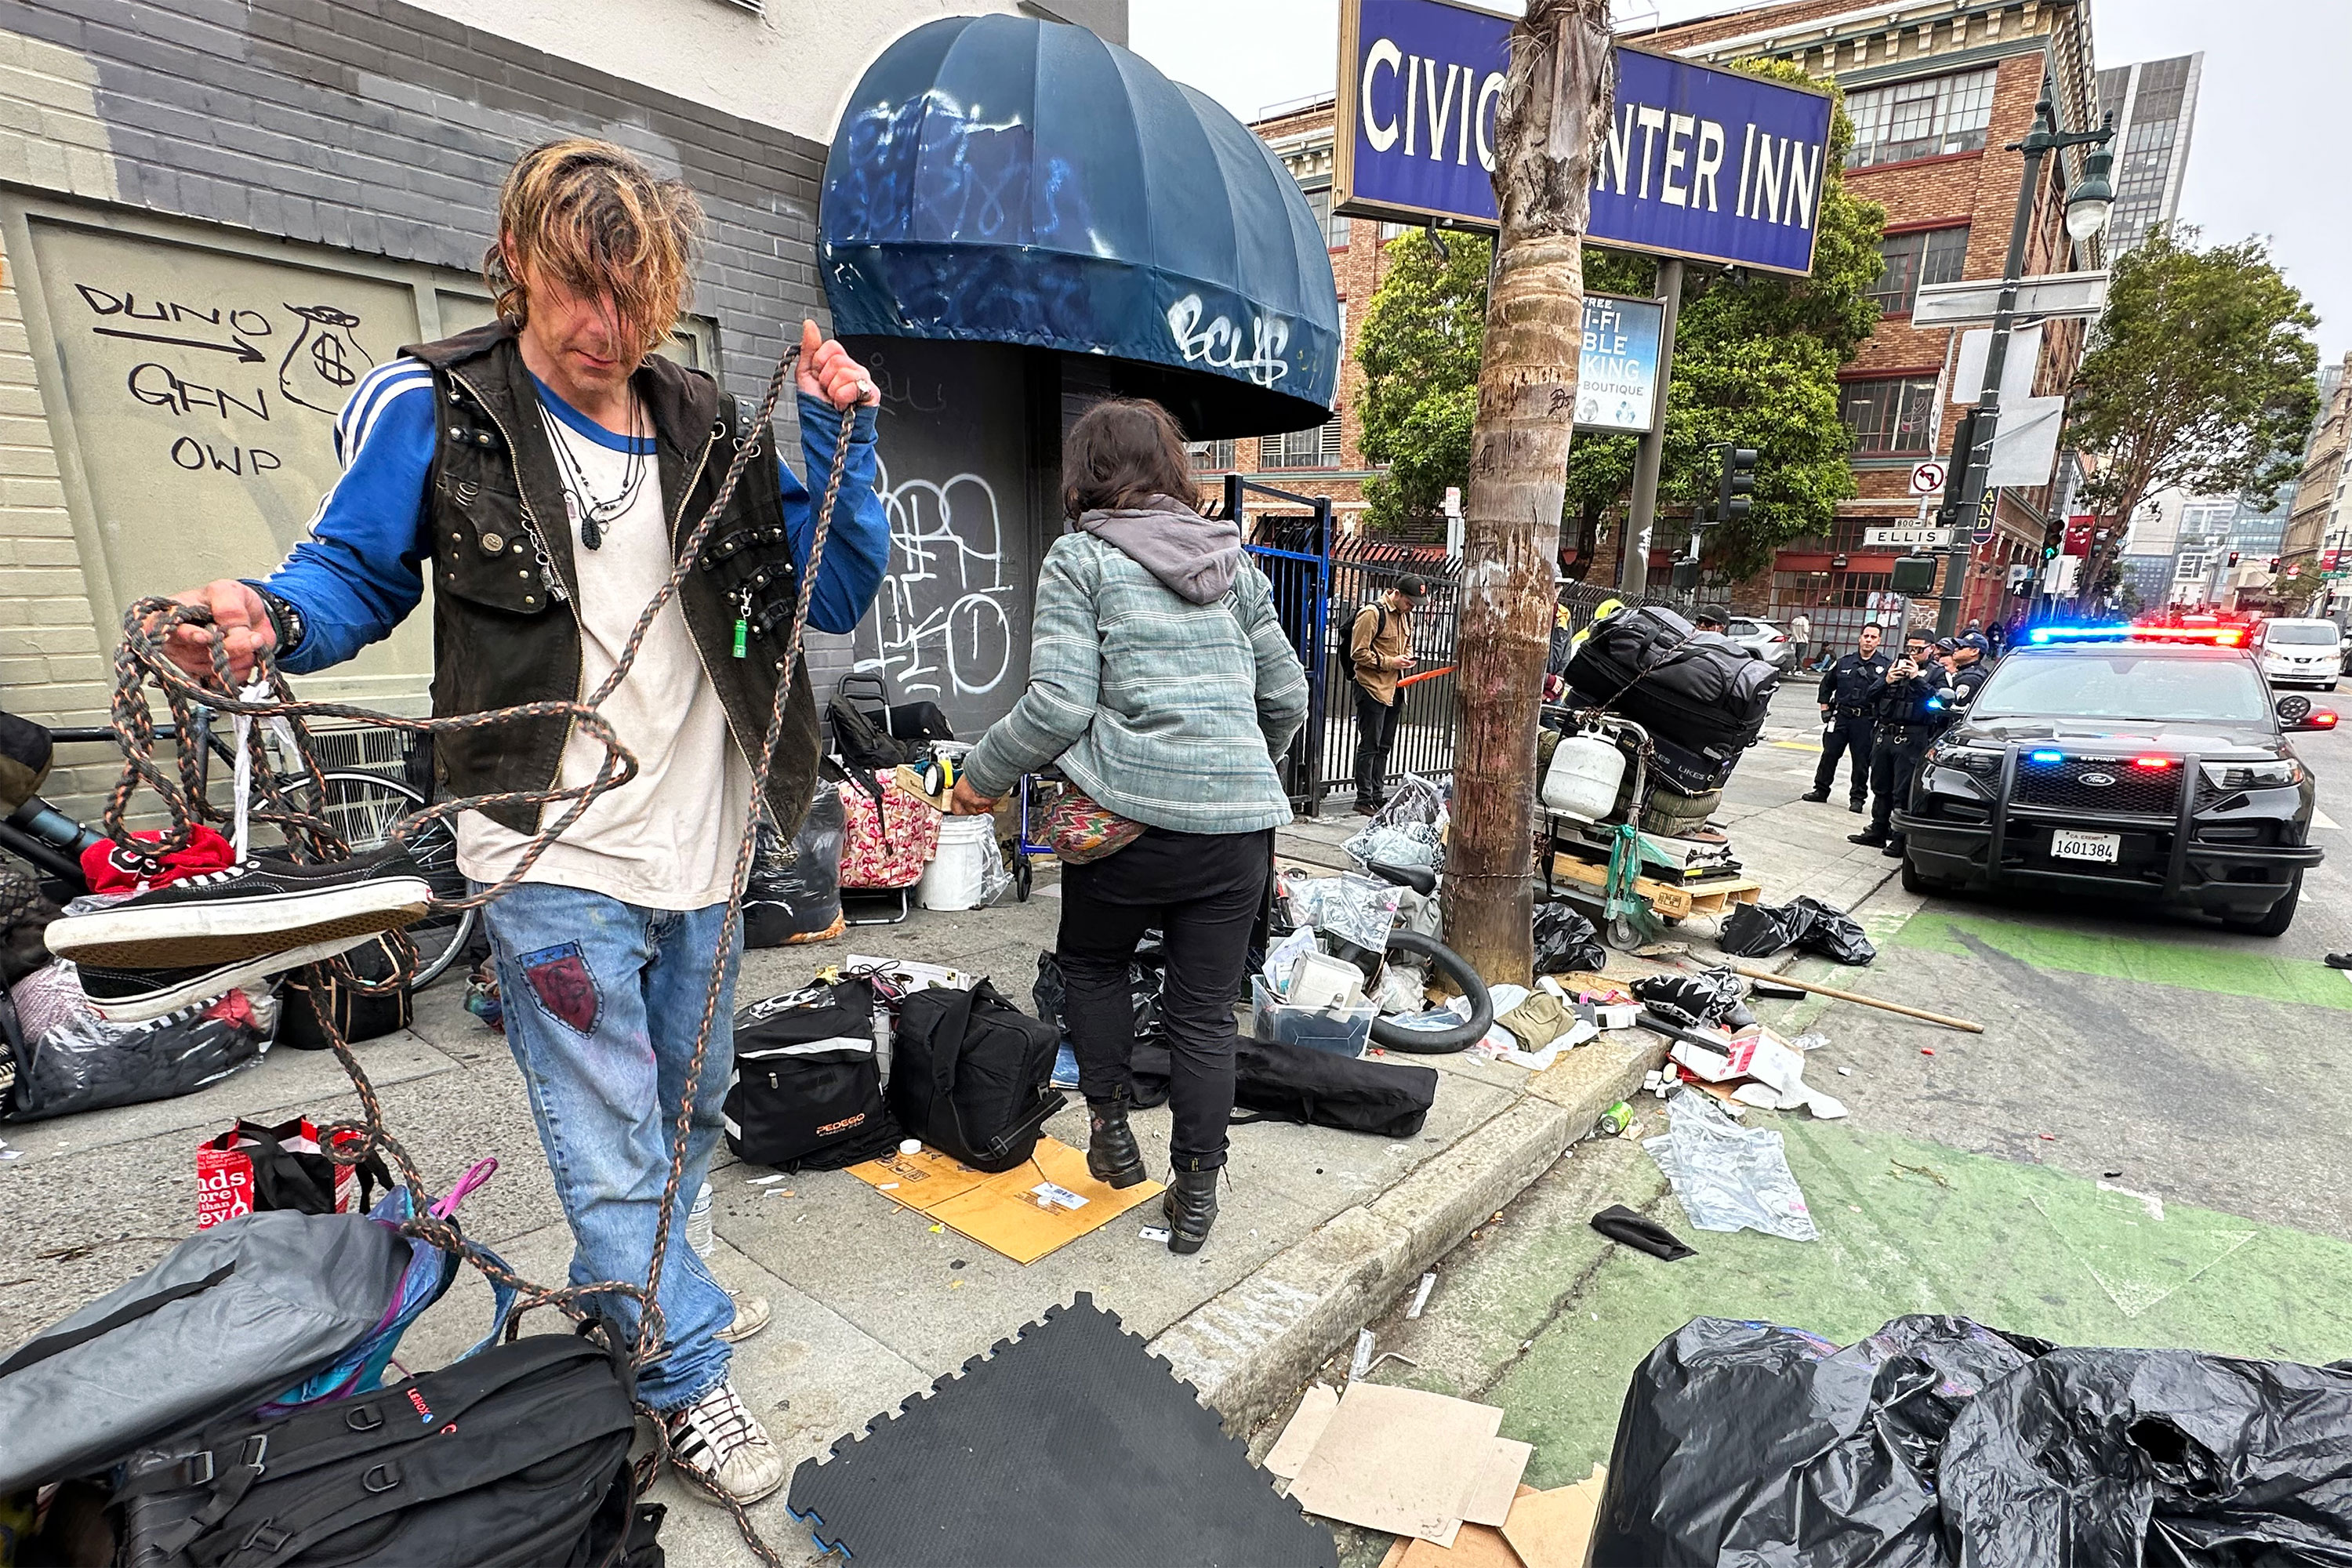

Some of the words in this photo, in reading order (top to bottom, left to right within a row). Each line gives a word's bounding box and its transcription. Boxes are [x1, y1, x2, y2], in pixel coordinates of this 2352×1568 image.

[1595, 101, 1724, 212] NTER
[1735, 122, 1820, 229] INN
[1583, 307, 1621, 332] I-FI
[1582, 331, 1628, 356] BLE
[1584, 354, 1640, 381] KING
[1583, 380, 1644, 396] BOUTIQUE
[172, 436, 281, 475] OWP
[1976, 489, 1996, 530] AND
[1878, 532, 1936, 542] ELLIS
[1678, 765, 1705, 780] LIKES
[2056, 840, 2112, 858] 1601384
[198, 1169, 247, 1192] nds
[198, 1189, 232, 1203] ore
[201, 1200, 230, 1211] than
[200, 1209, 229, 1225] ey
[408, 1388, 431, 1416] LENOX
